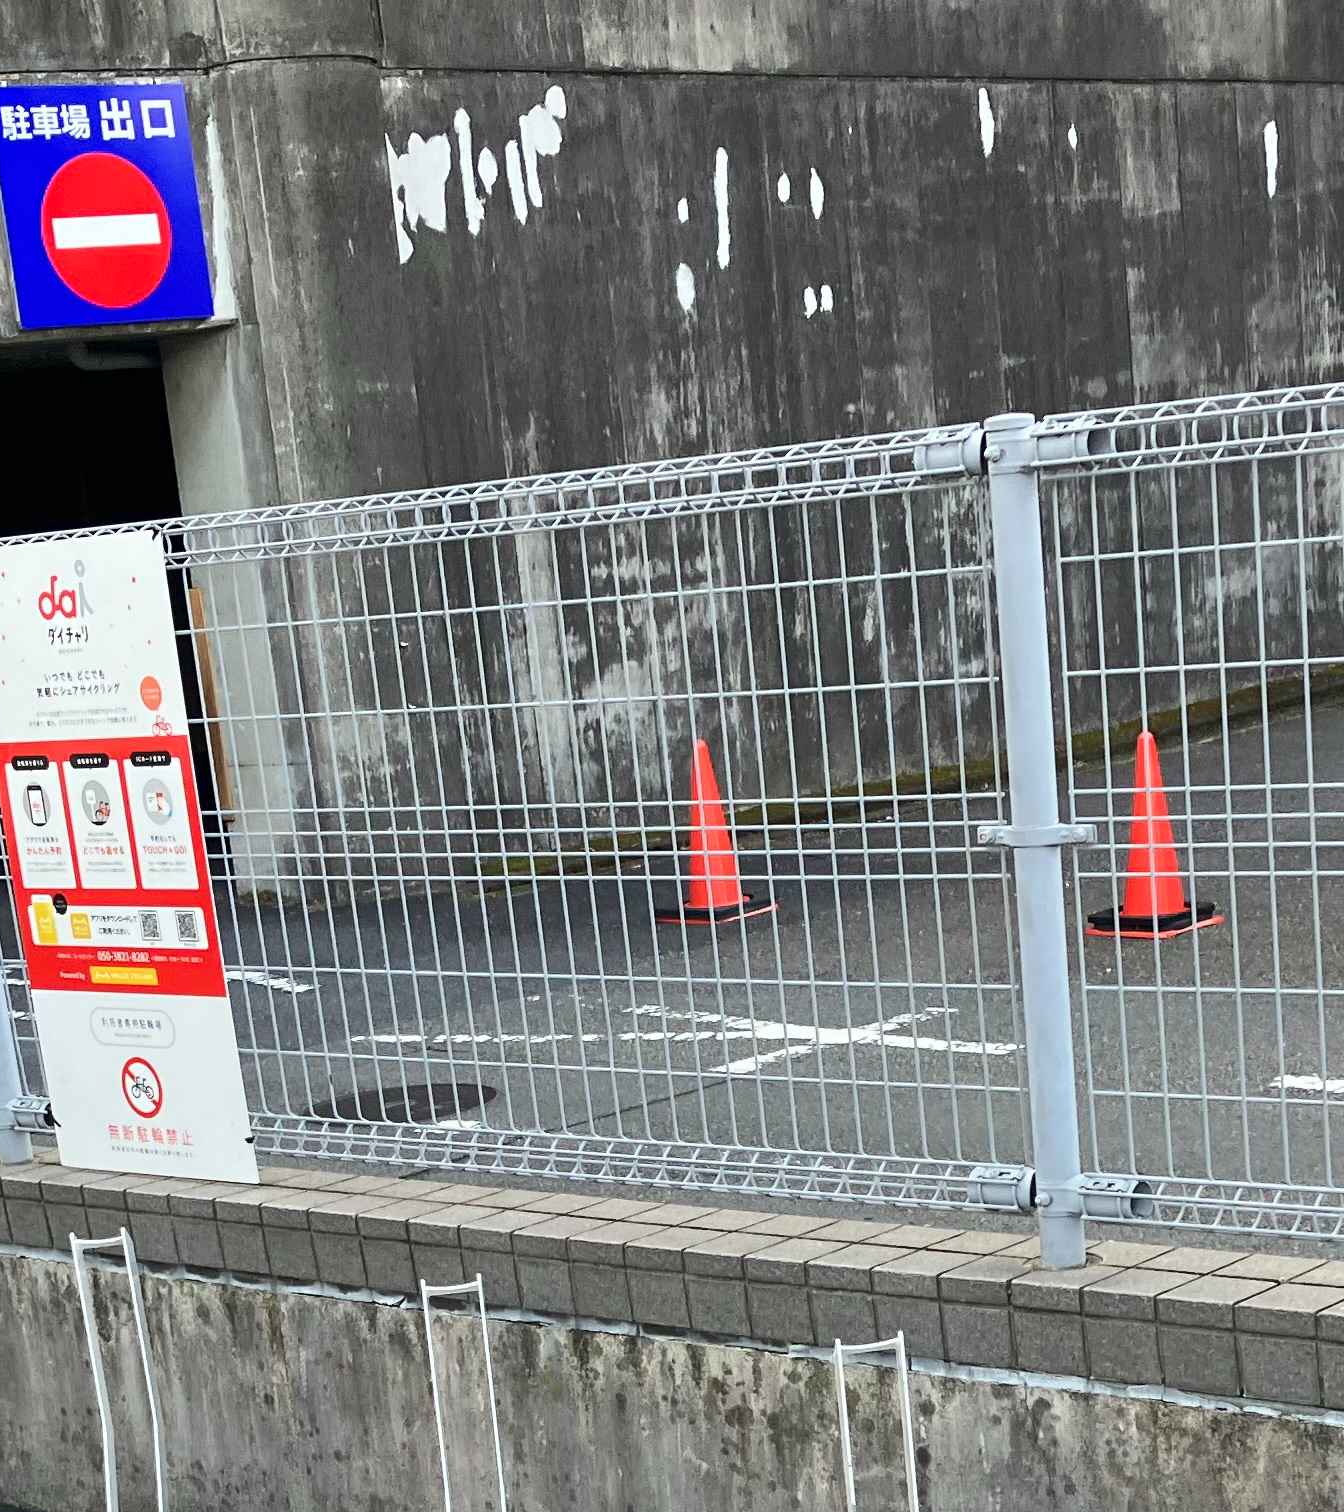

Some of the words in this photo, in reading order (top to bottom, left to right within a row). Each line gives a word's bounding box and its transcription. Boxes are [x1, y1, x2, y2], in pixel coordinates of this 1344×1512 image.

[0, 104, 91, 141] 駐車場
[99, 97, 176, 141] 出口
[47, 624, 89, 646] ダイチャリ
